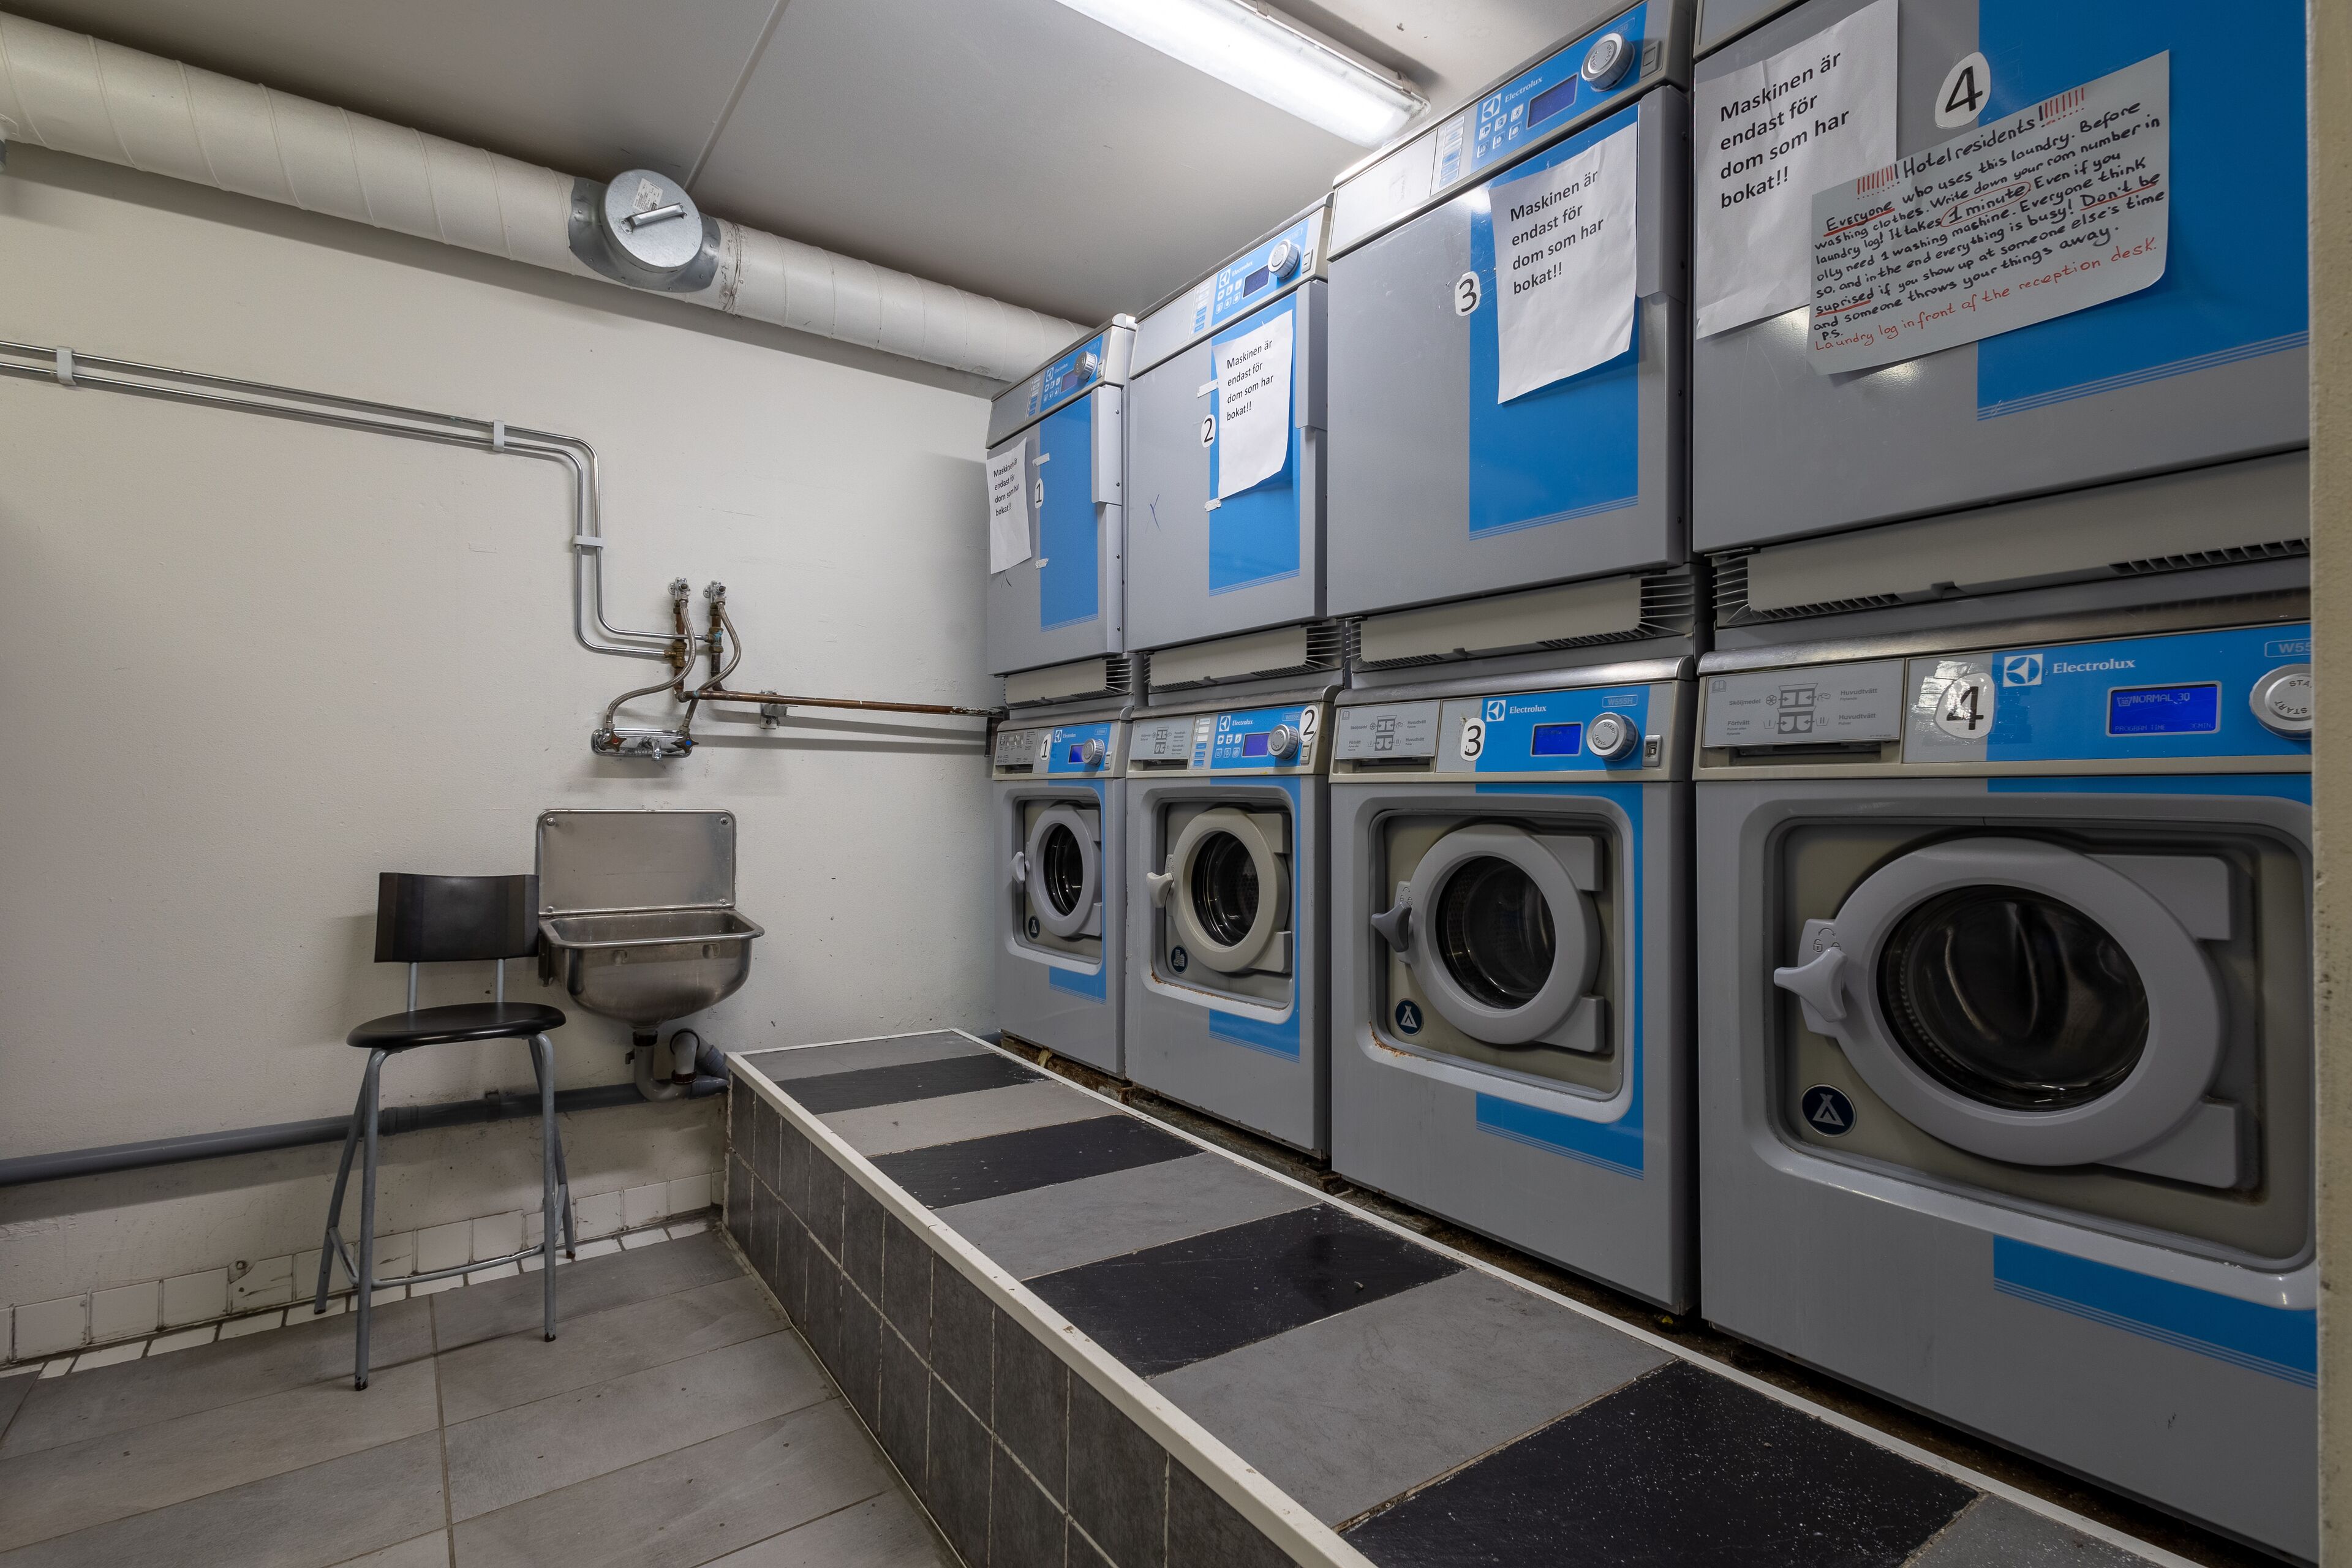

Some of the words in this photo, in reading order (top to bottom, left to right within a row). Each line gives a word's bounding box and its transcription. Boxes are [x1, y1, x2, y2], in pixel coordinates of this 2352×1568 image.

[1505, 77, 1542, 104] Electrolux
[1721, 66, 1814, 122] Maskinen
[1820, 53, 1841, 73] är
[1945, 66, 1983, 113] 4
[1721, 111, 1785, 150] endast
[1790, 93, 1817, 119] för
[1721, 152, 1763, 179] dom
[1770, 132, 1807, 160] som
[1815, 110, 1849, 137] har
[1826, 201, 1893, 231] Everyone
[1902, 185, 1933, 203] who
[1939, 171, 1972, 189] uses
[1978, 157, 2007, 174] this
[2011, 133, 2075, 161] laundry.
[2080, 102, 2141, 133] Before
[1904, 147, 1952, 178] Hotel
[1510, 183, 1579, 222] Maskinen
[1584, 171, 1598, 187] är
[1721, 166, 1789, 208] bokat!!
[1815, 228, 1868, 250] washing
[1873, 208, 1929, 231] clothes.
[1930, 188, 1968, 208] Write
[1973, 176, 2008, 195] down
[2014, 162, 2043, 180] your
[2048, 151, 2075, 166] rom
[2081, 124, 2141, 153] number
[2145, 114, 2160, 129] in
[1817, 246, 1860, 265] laundry
[1864, 232, 1884, 250] log!
[1890, 229, 1902, 240] It
[1904, 217, 1942, 235] takes
[1948, 206, 1962, 224] 1
[2034, 172, 2070, 189] Even
[2075, 160, 2088, 175] if
[2093, 153, 2120, 172] you
[1846, 255, 1875, 272] need
[1881, 252, 1890, 261] 1
[1893, 234, 1948, 257] washing
[2020, 179, 2094, 213] Everyone
[2098, 156, 2146, 182] think
[1512, 216, 1559, 246] endast
[1562, 205, 1583, 224] för
[1839, 275, 1862, 290] and
[1877, 265, 1902, 277] the
[1906, 252, 1931, 268] end
[2010, 225, 2022, 234] is
[2027, 199, 2074, 225] busy!
[2080, 181, 2132, 207] Don't
[2139, 173, 2160, 186] be
[1513, 250, 1544, 270] dom
[1548, 234, 1576, 255] som
[1581, 219, 1604, 239] har
[1816, 288, 1874, 314] suprised
[1878, 284, 1891, 296] if
[1898, 278, 1918, 293] you
[1923, 266, 1954, 280] show
[1958, 260, 1974, 271] up
[1979, 248, 1995, 262] at
[2001, 225, 2065, 254] someone
[2071, 205, 2119, 228] else's
[2126, 191, 2165, 209] time
[1514, 262, 1562, 295] bokat!!
[1814, 316, 1838, 331] and
[1844, 298, 1903, 323] someone
[1907, 281, 1957, 302] throws
[1963, 266, 1997, 289] your
[2000, 247, 2052, 267] things
[2059, 227, 2119, 247] away.
[1815, 332, 1874, 351] Laundry
[1879, 325, 1898, 339] log
[1917, 303, 1956, 329] front
[1961, 293, 1976, 311] of
[1981, 288, 2010, 302] the
[2019, 259, 2100, 290] reception
[2111, 236, 2157, 262] desk.
[1459, 278, 1477, 312] 3
[1822, 330, 1842, 341] P.S.
[1227, 346, 1262, 369] Maskinen
[1264, 340, 1272, 350] är
[1227, 368, 1251, 386] endast
[1253, 363, 1263, 374] för
[1227, 394, 1243, 404] dom
[1245, 383, 1259, 396] som
[1261, 375, 1273, 387] har
[1227, 401, 1251, 421] bokat!!
[1204, 418, 1213, 443] 2
[993, 462, 1014, 478] Maskinen
[994, 478, 1009, 491] endast
[995, 494, 1006, 503] dom
[1036, 483, 1042, 503] 1
[995, 502, 1011, 516] bokat!!
[2052, 658, 2136, 674] Electrolux
[2132, 694, 2173, 704] NORMAL
[2290, 680, 2312, 688] STA
[1303, 709, 1315, 736] 2
[1509, 705, 1547, 714] Electrolux
[1947, 687, 1984, 730] 4
[2274, 701, 2307, 714] START
[1041, 739, 1048, 758] 1
[1464, 725, 1482, 756] 3
